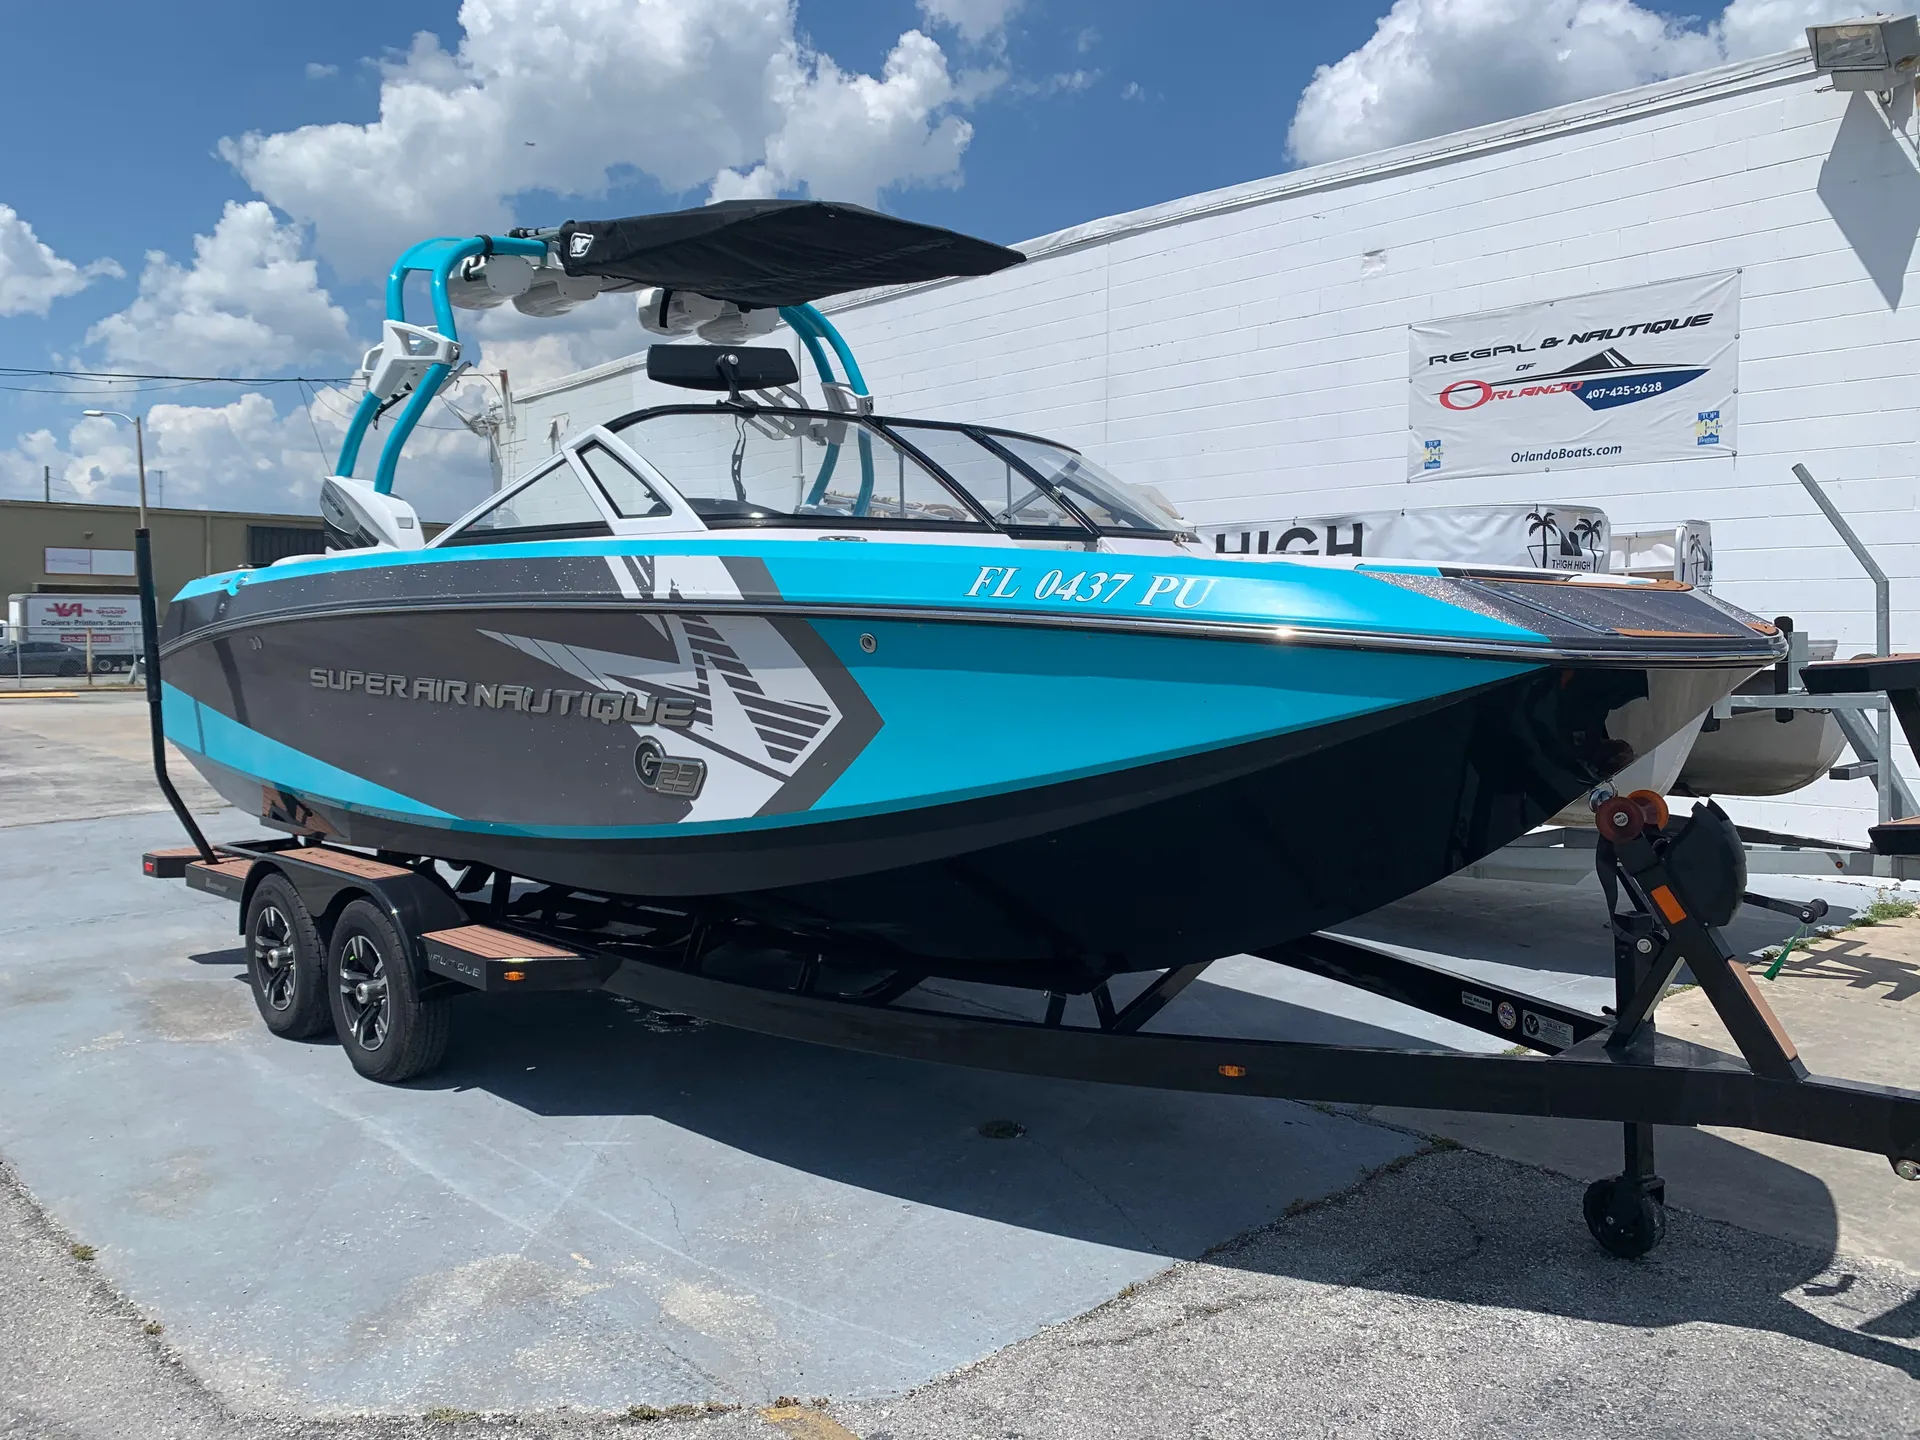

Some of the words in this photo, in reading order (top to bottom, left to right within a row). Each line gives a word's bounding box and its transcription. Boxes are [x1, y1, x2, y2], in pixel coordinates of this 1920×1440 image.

[1429, 343, 1536, 366] REGAL
[1540, 336, 1565, 349] &
[1567, 313, 1714, 346] NAUTIQUE
[1515, 362, 1537, 372] OF
[1439, 379, 1584, 411] ORLANDO
[1585, 382, 1662, 400] 407-425-2628
[1510, 445, 1623, 463] OrlandoBoats.com
[1551, 559, 1573, 570] THIGH
[1574, 560, 1591, 571] HIGH
[964, 566, 1021, 599] FL
[1034, 569, 1136, 603] 0437
[1136, 574, 1220, 609] PU
[41, 619, 70, 627] Copiers
[309, 667, 408, 698] SUPER
[412, 676, 468, 706] AIR
[474, 682, 699, 728] NAUTIQUE
